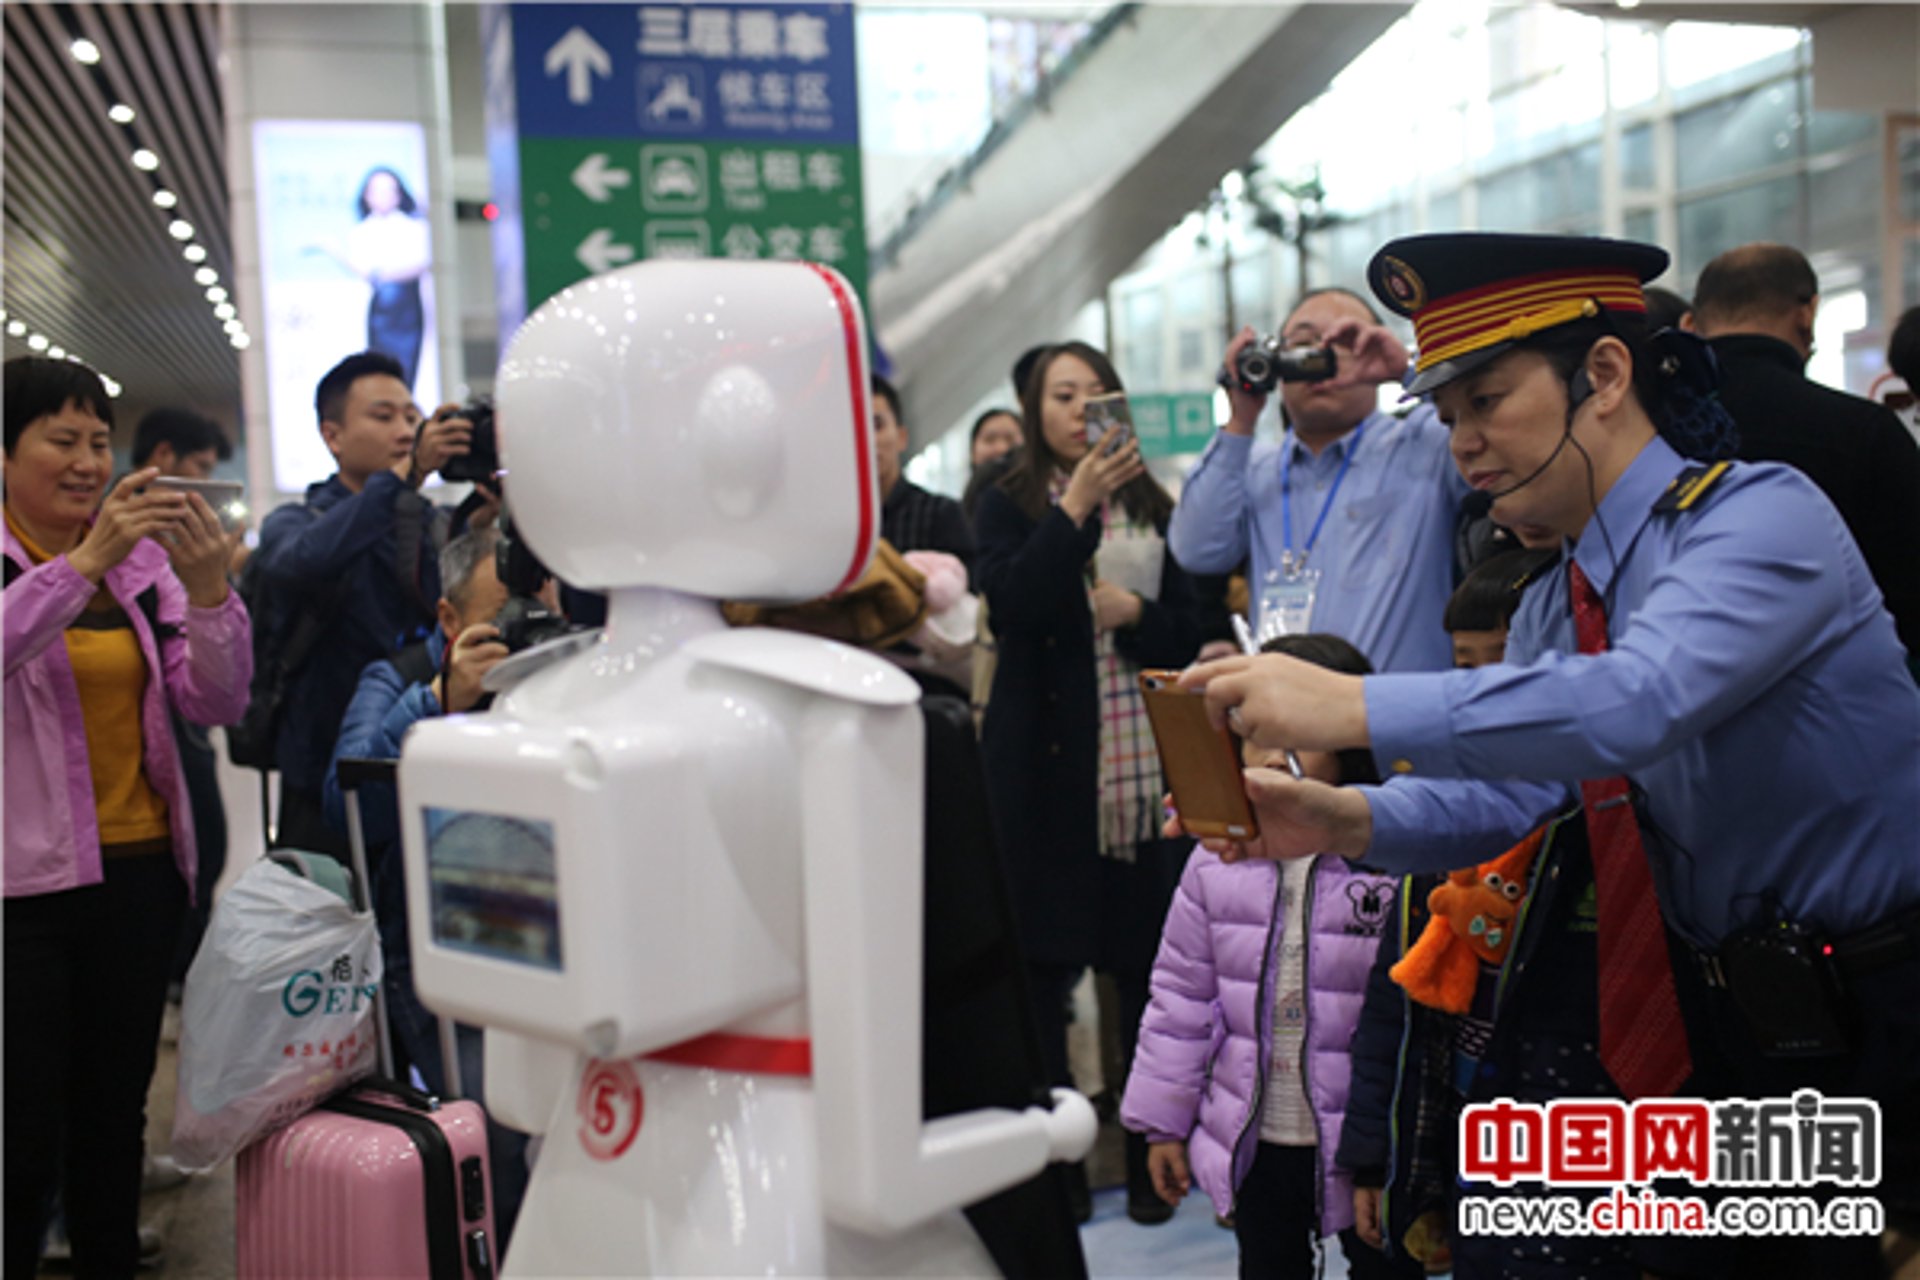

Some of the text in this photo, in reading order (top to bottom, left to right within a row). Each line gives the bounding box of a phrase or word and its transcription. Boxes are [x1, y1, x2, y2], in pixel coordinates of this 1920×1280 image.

[720, 149, 843, 191] 出租车
[593, 1085, 616, 1135] 5
